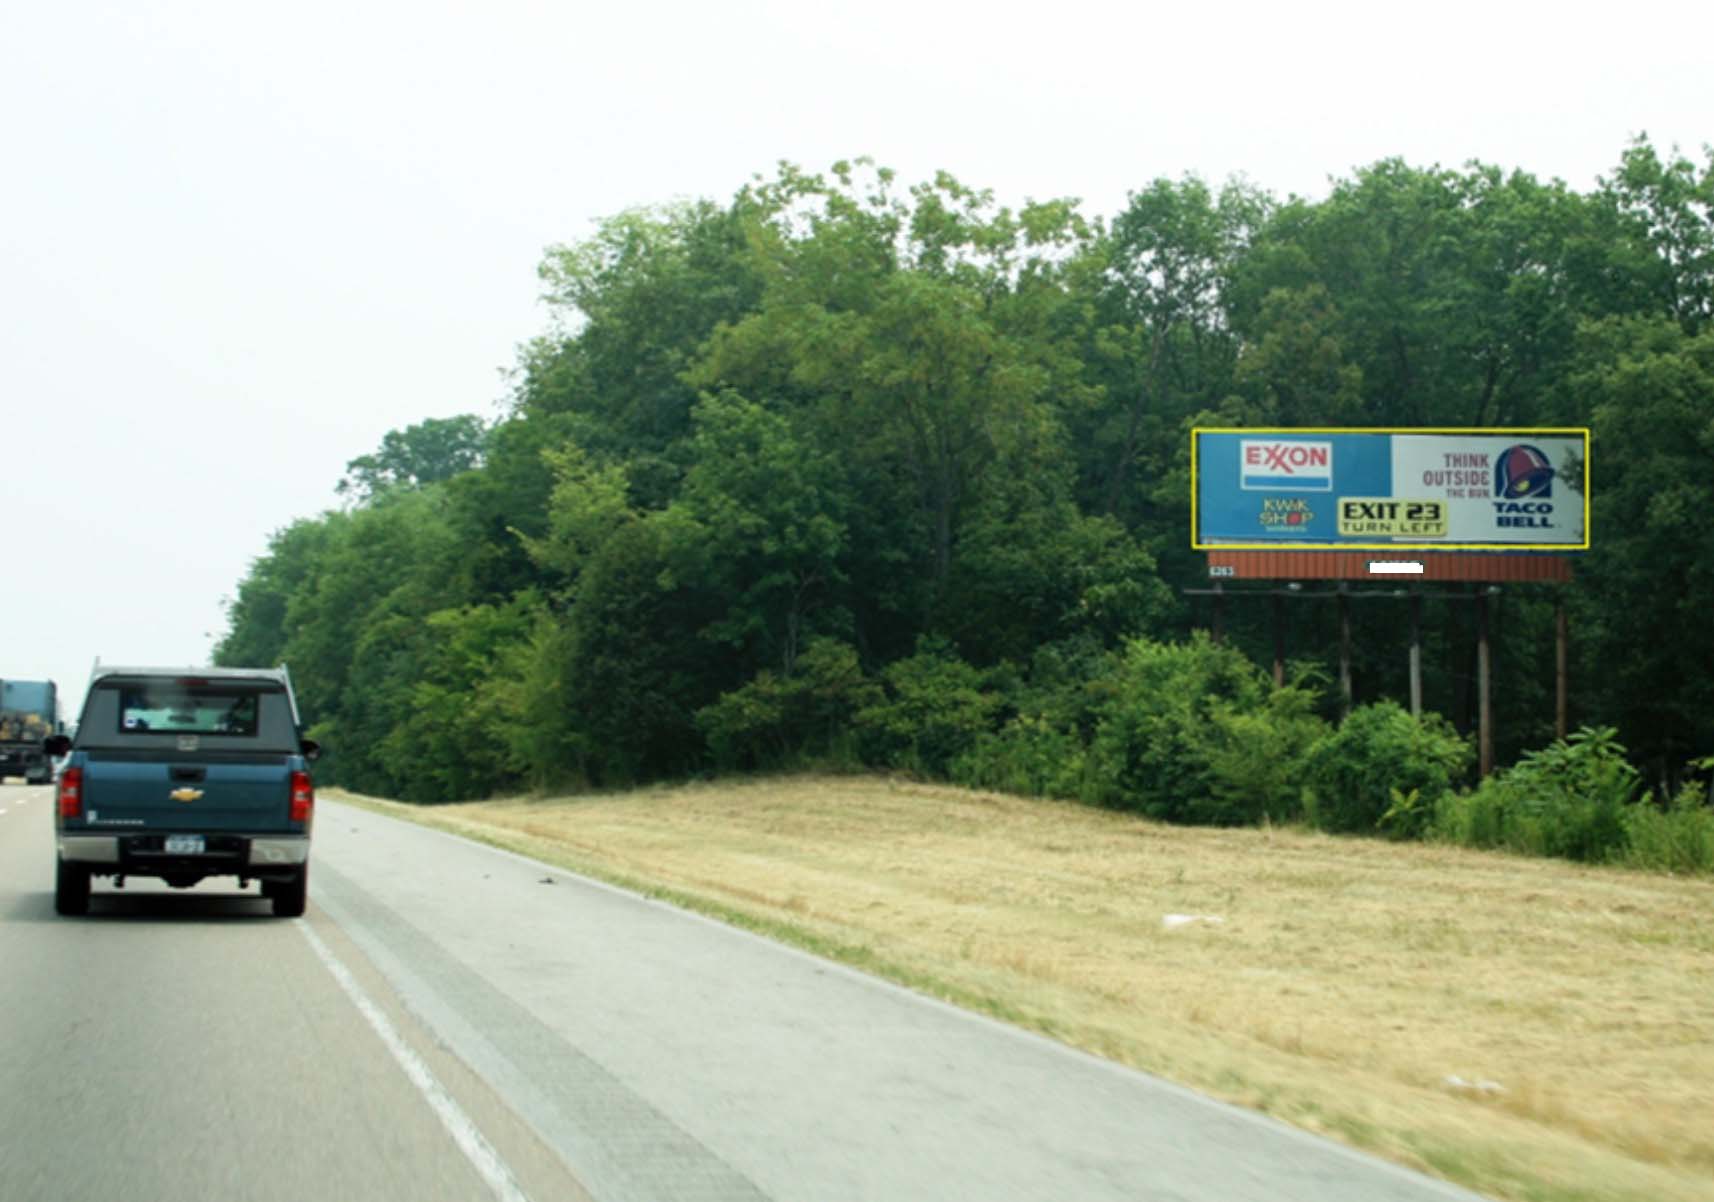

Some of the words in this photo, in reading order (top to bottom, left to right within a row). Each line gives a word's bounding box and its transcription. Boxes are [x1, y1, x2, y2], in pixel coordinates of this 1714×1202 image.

[1245, 445, 1328, 474] EXXON
[1444, 453, 1489, 468] THINK
[1423, 470, 1490, 486] OUTSIDE
[1343, 502, 1400, 520] EXIT
[1406, 503, 1441, 521] 23
[1494, 502, 1553, 514] TACO
[1343, 522, 1391, 533] TURN
[1399, 523, 1443, 533] LEFT
[1496, 516, 1555, 529] BELL
